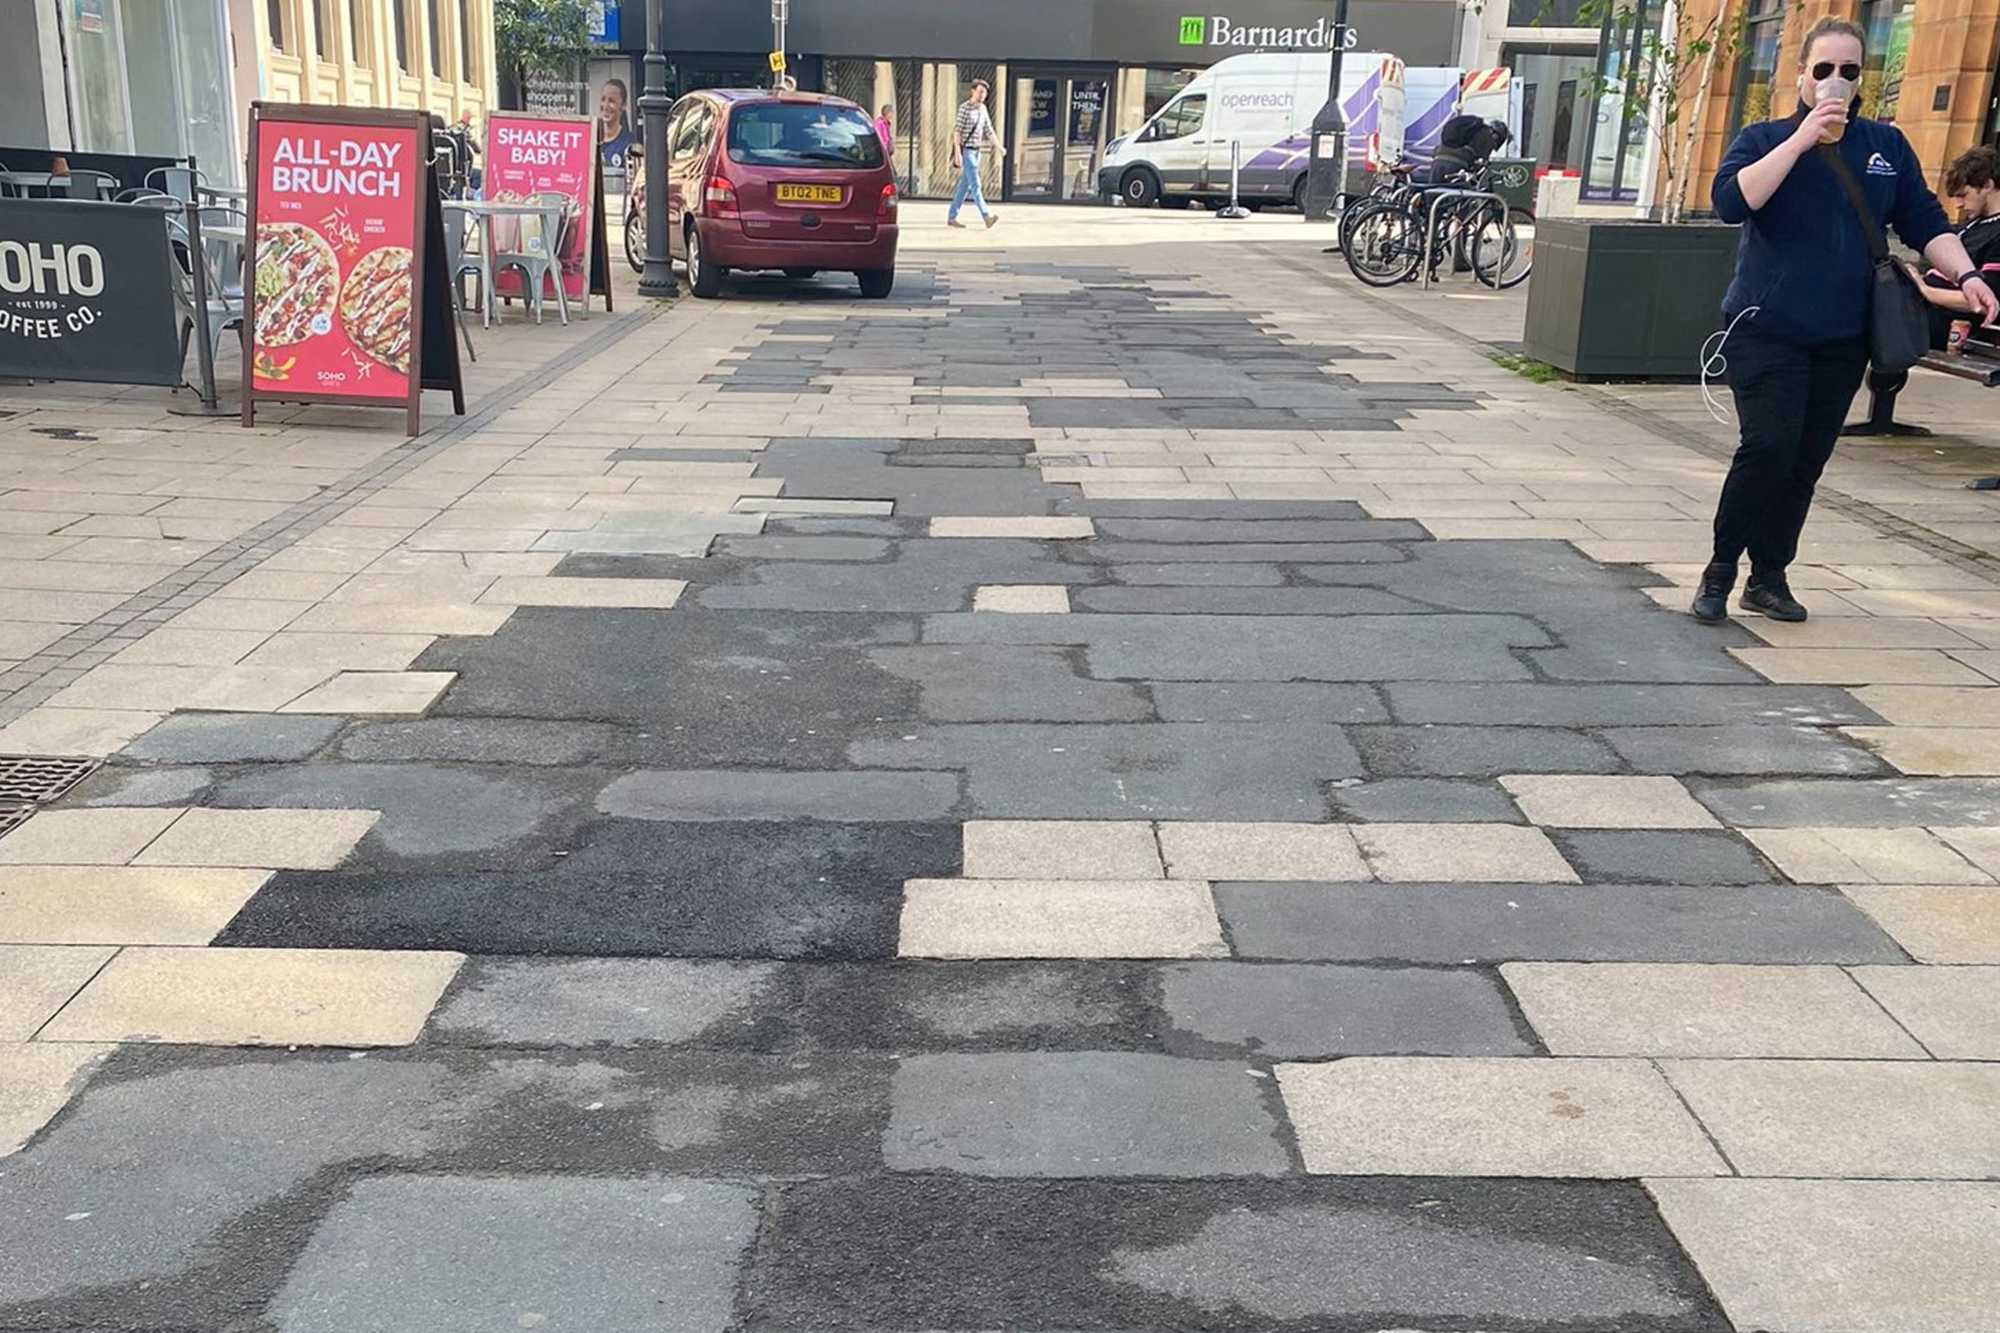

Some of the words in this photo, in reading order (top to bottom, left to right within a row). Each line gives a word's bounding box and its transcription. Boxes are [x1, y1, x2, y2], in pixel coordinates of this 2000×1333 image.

[1210, 16, 1358, 48] Barnards
[1221, 92, 1294, 109] openreach
[497, 128, 561, 148] SHAKE
[563, 131, 582, 149] IT
[272, 137, 402, 169] ALL-DAY
[510, 147, 566, 167] BABY!
[272, 166, 400, 198] BRUNCH
[816, 188, 837, 199] TNE
[16, 300, 32, 309] est
[34, 300, 58, 310] 1999
[66, 305, 103, 332] CO.
[316, 371, 346, 381] SOHO
